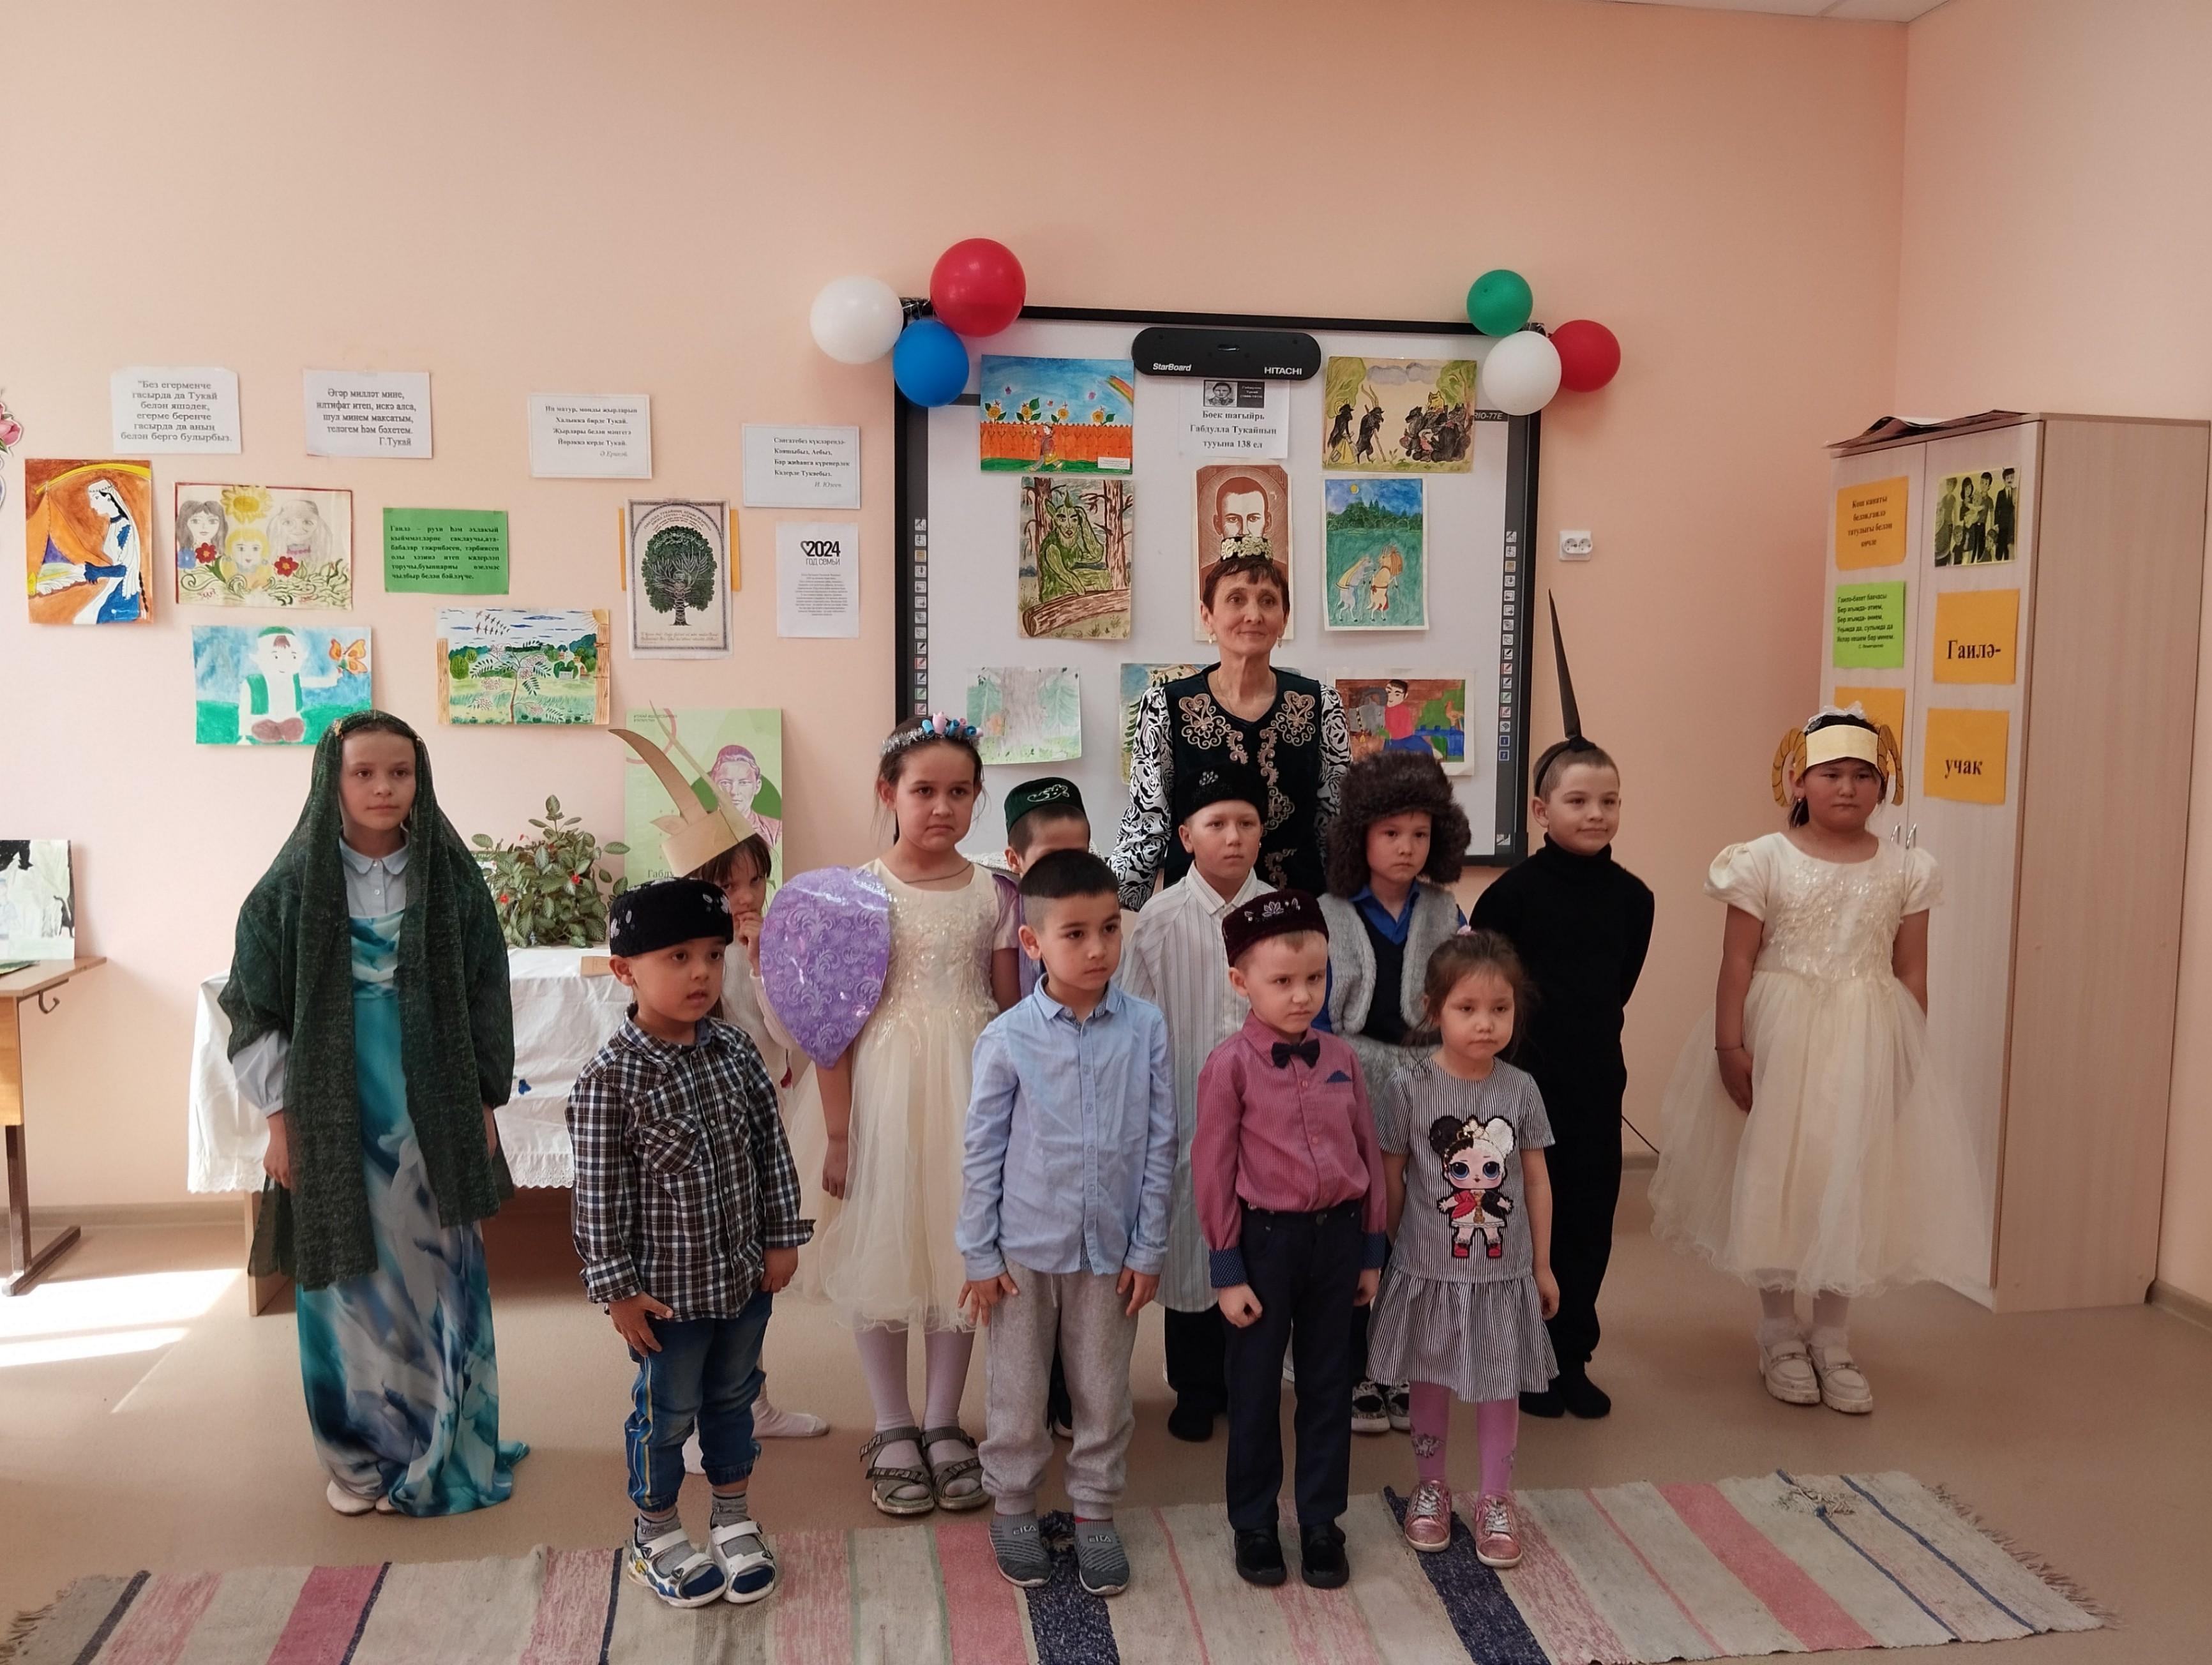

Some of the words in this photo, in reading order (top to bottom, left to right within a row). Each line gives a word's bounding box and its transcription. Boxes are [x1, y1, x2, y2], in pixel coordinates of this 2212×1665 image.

[1153, 363, 1192, 372] StarBoard
[1265, 366, 1302, 375] HITACHI
[132, 392, 171, 400] гасырда
[188, 392, 217, 401] Тукай
[328, 388, 347, 399] Әгәр
[317, 401, 350, 411] илтифат
[353, 402, 373, 411] итеп,
[172, 412, 211, 421] беренче
[1226, 412, 1265, 421] шагыйрь
[134, 423, 172, 432] гасырда
[379, 425, 412, 433] бәхетем.
[1190, 424, 1230, 433] Габдулла
[151, 433, 177, 441] бергә
[181, 433, 232, 442] булырбыз.
[379, 437, 411, 447] Г.Тукай
[1203, 441, 1234, 449] тууына
[806, 541, 841, 557] 2024
[1946, 640, 2001, 660] Гаилә-
[1945, 758, 1983, 779] учак
